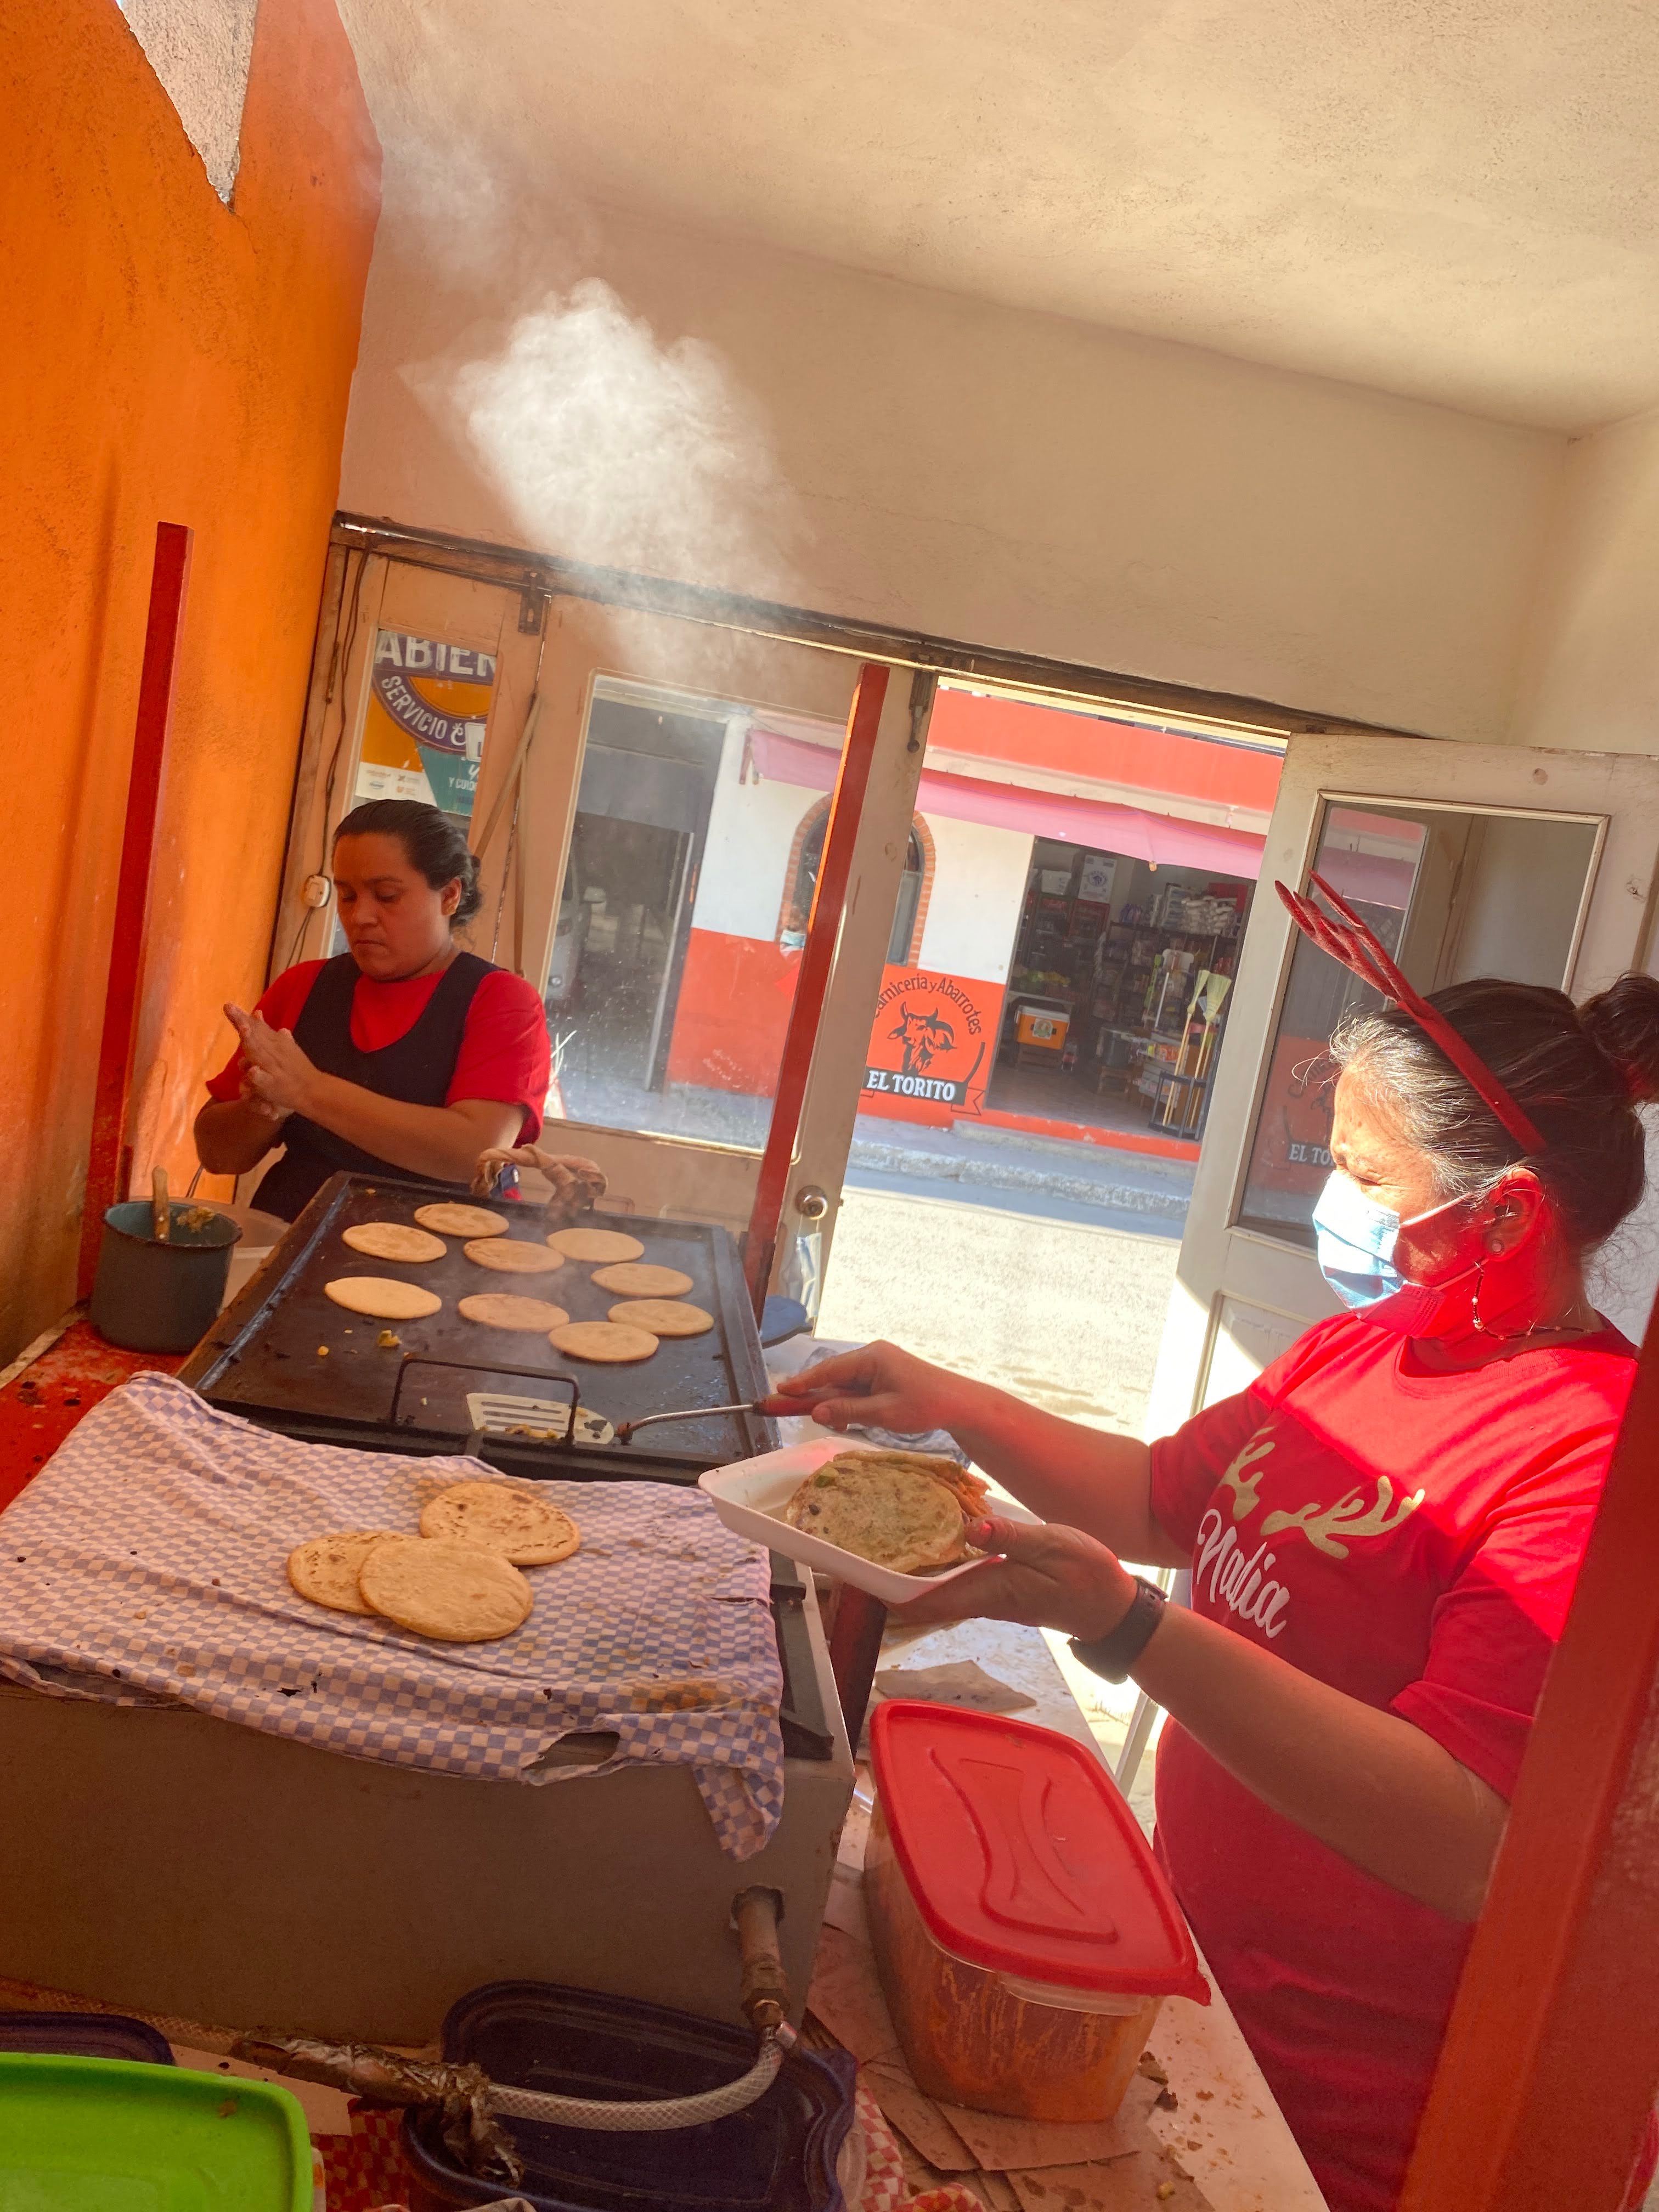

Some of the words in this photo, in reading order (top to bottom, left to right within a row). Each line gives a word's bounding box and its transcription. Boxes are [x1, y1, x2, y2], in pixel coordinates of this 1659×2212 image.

[381, 675, 448, 740] SERVICIO
[936, 977, 981, 1035] Abarrotes
[866, 1070, 889, 1091] EL
[892, 1074, 956, 1101] TORITO
[1289, 1143, 1307, 1162] EL
[1197, 1509, 1290, 1639] Nadia
